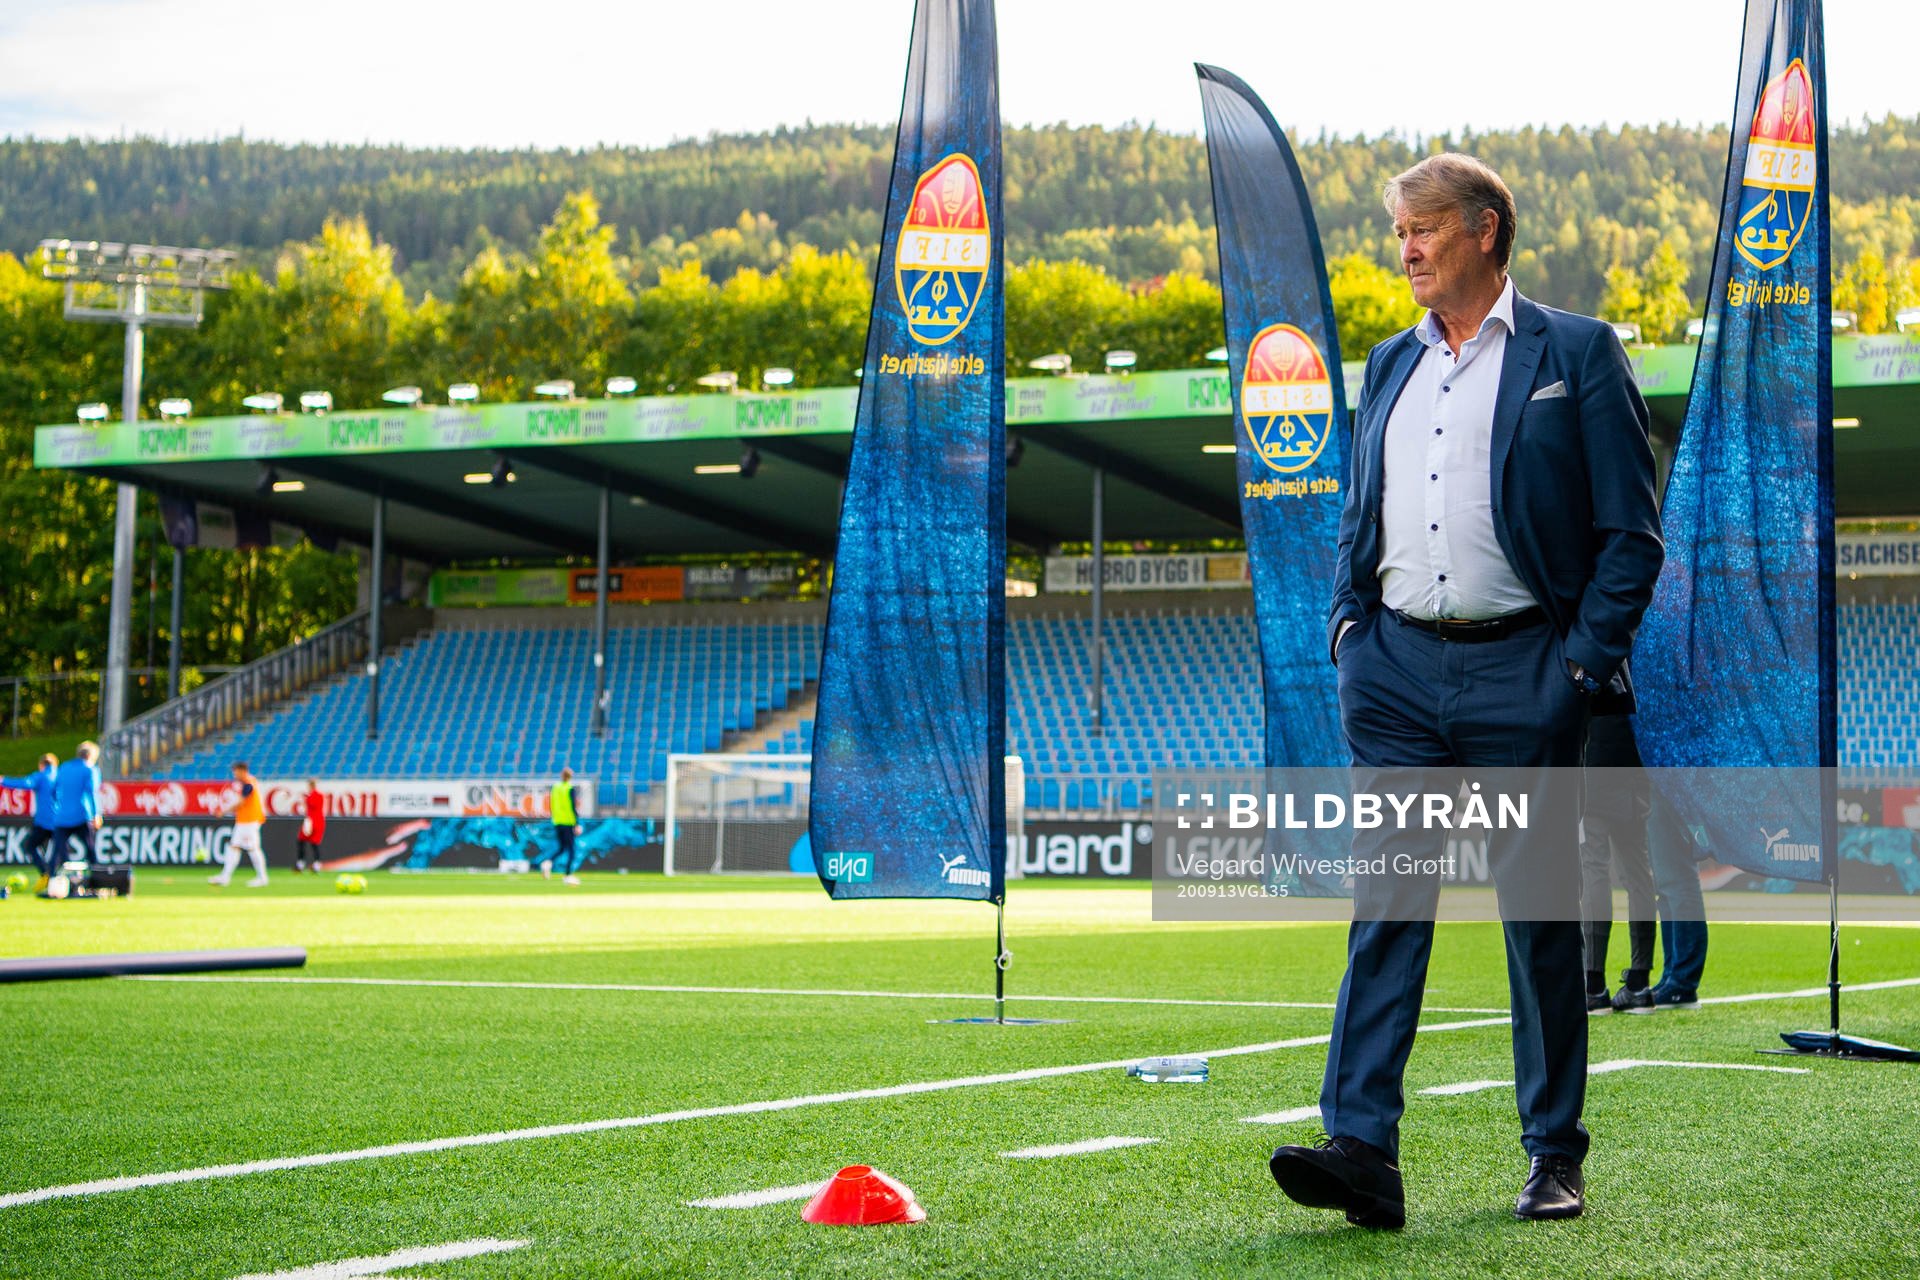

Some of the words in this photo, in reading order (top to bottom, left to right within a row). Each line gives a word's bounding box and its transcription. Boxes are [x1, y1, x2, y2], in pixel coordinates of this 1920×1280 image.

[1019, 387, 1046, 401] mini
[1019, 403, 1044, 418] pris
[1140, 558, 1189, 584] BYGG
